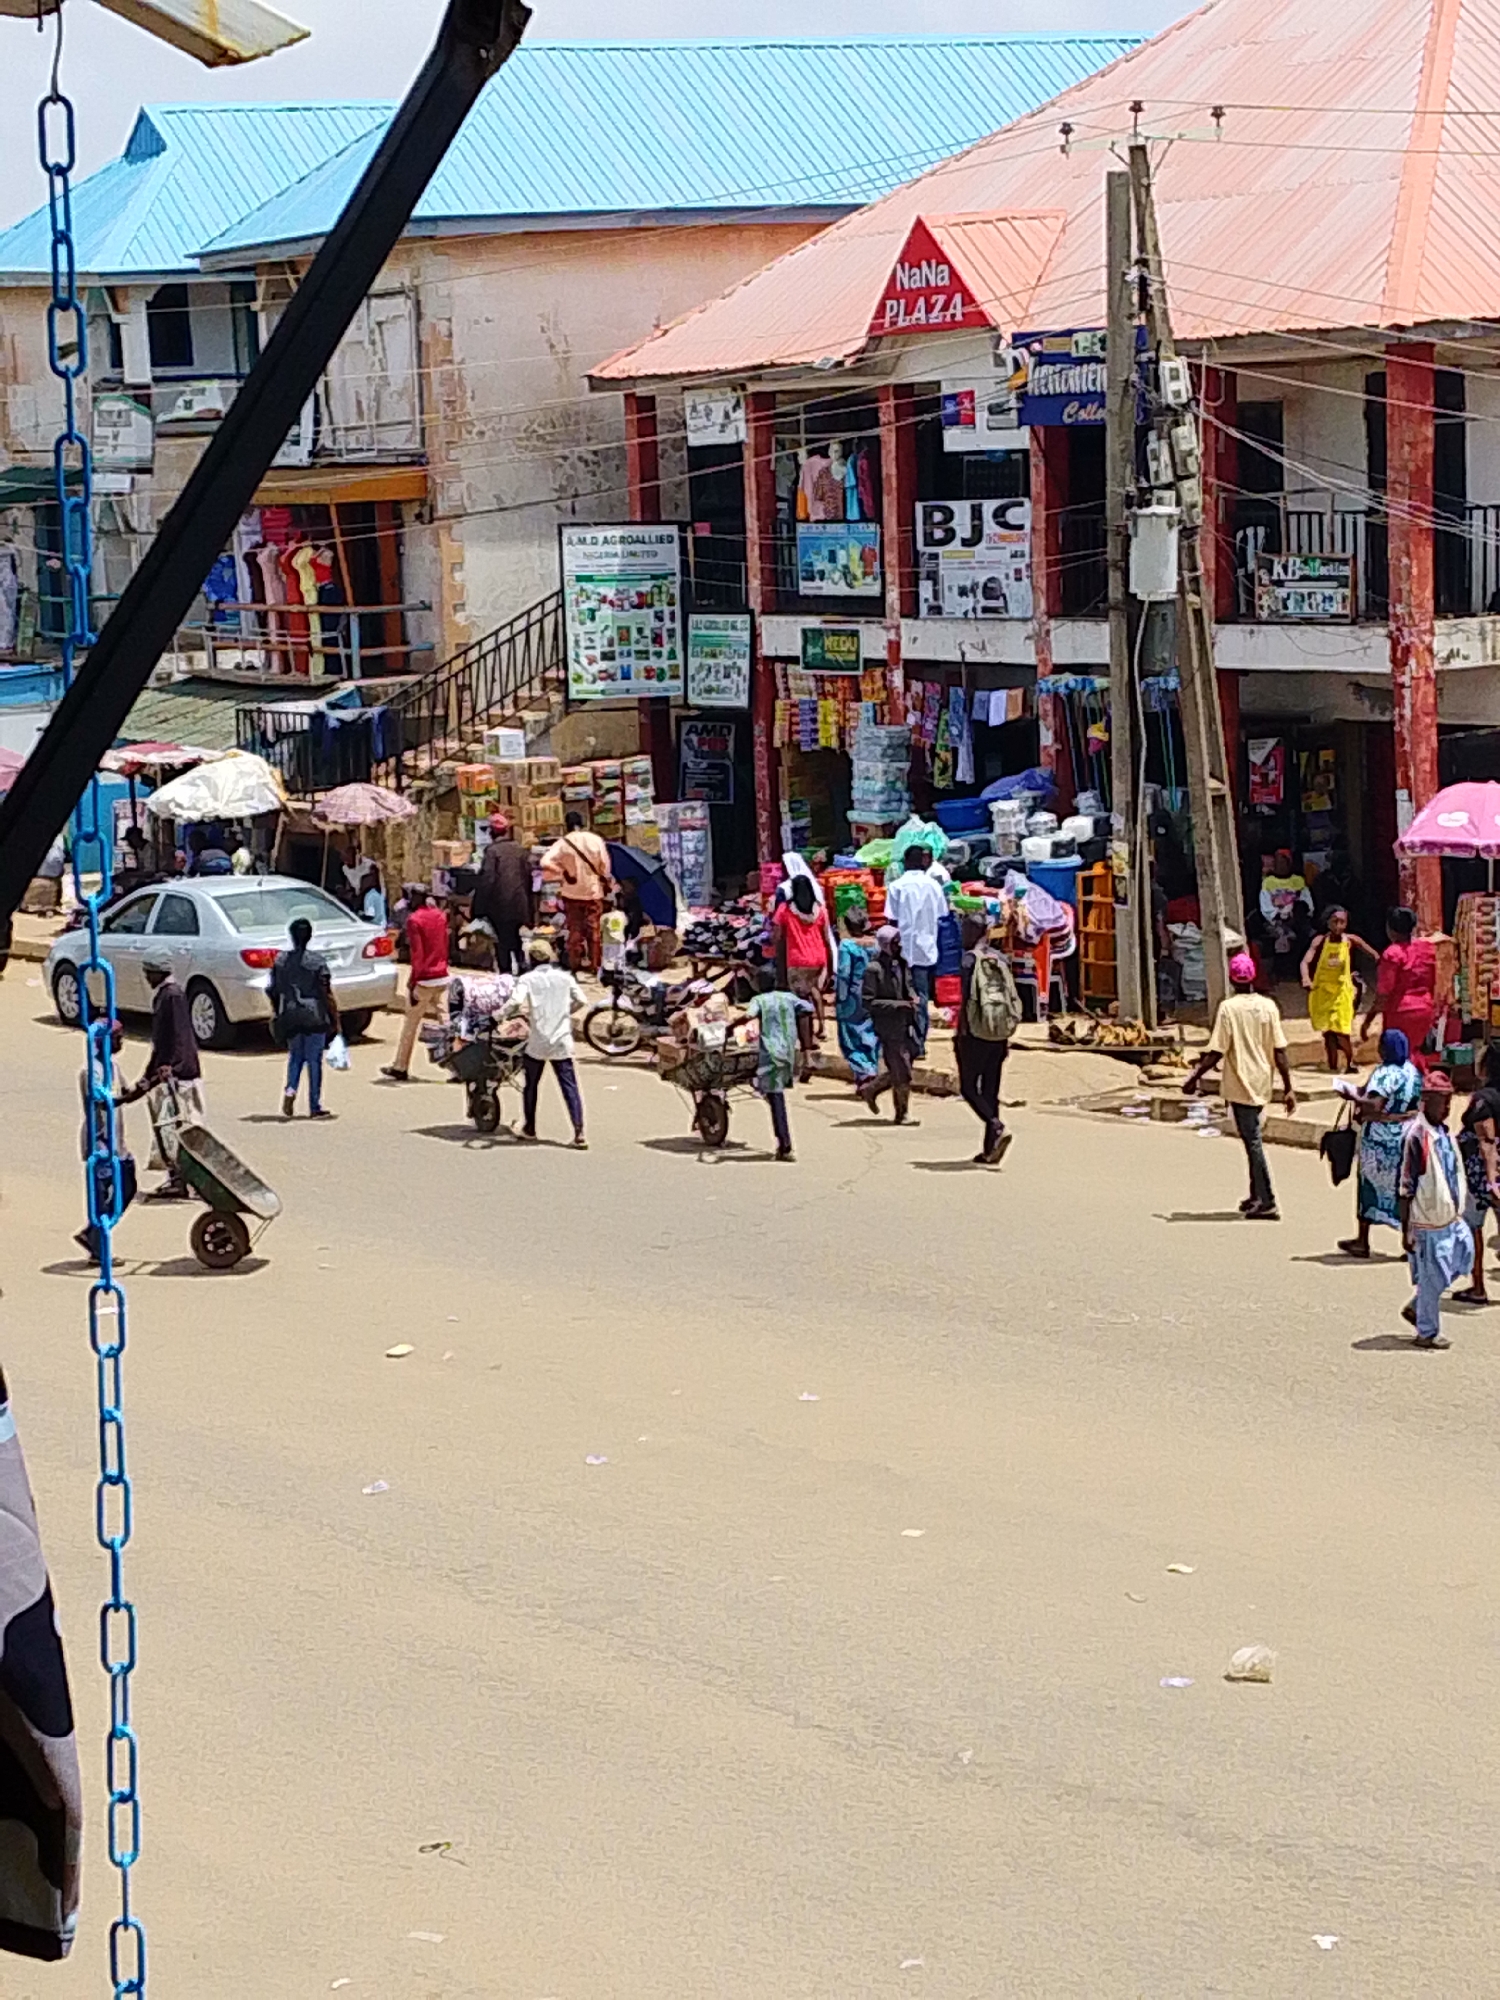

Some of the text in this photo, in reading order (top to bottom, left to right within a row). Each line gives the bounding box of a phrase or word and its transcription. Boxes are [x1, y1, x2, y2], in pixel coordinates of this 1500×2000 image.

[895, 258, 950, 290] NaNa
[884, 293, 963, 328] PLAZA
[601, 534, 675, 546] AGROALLIED
[922, 501, 1025, 547] BJC
[685, 724, 733, 737] AMD
